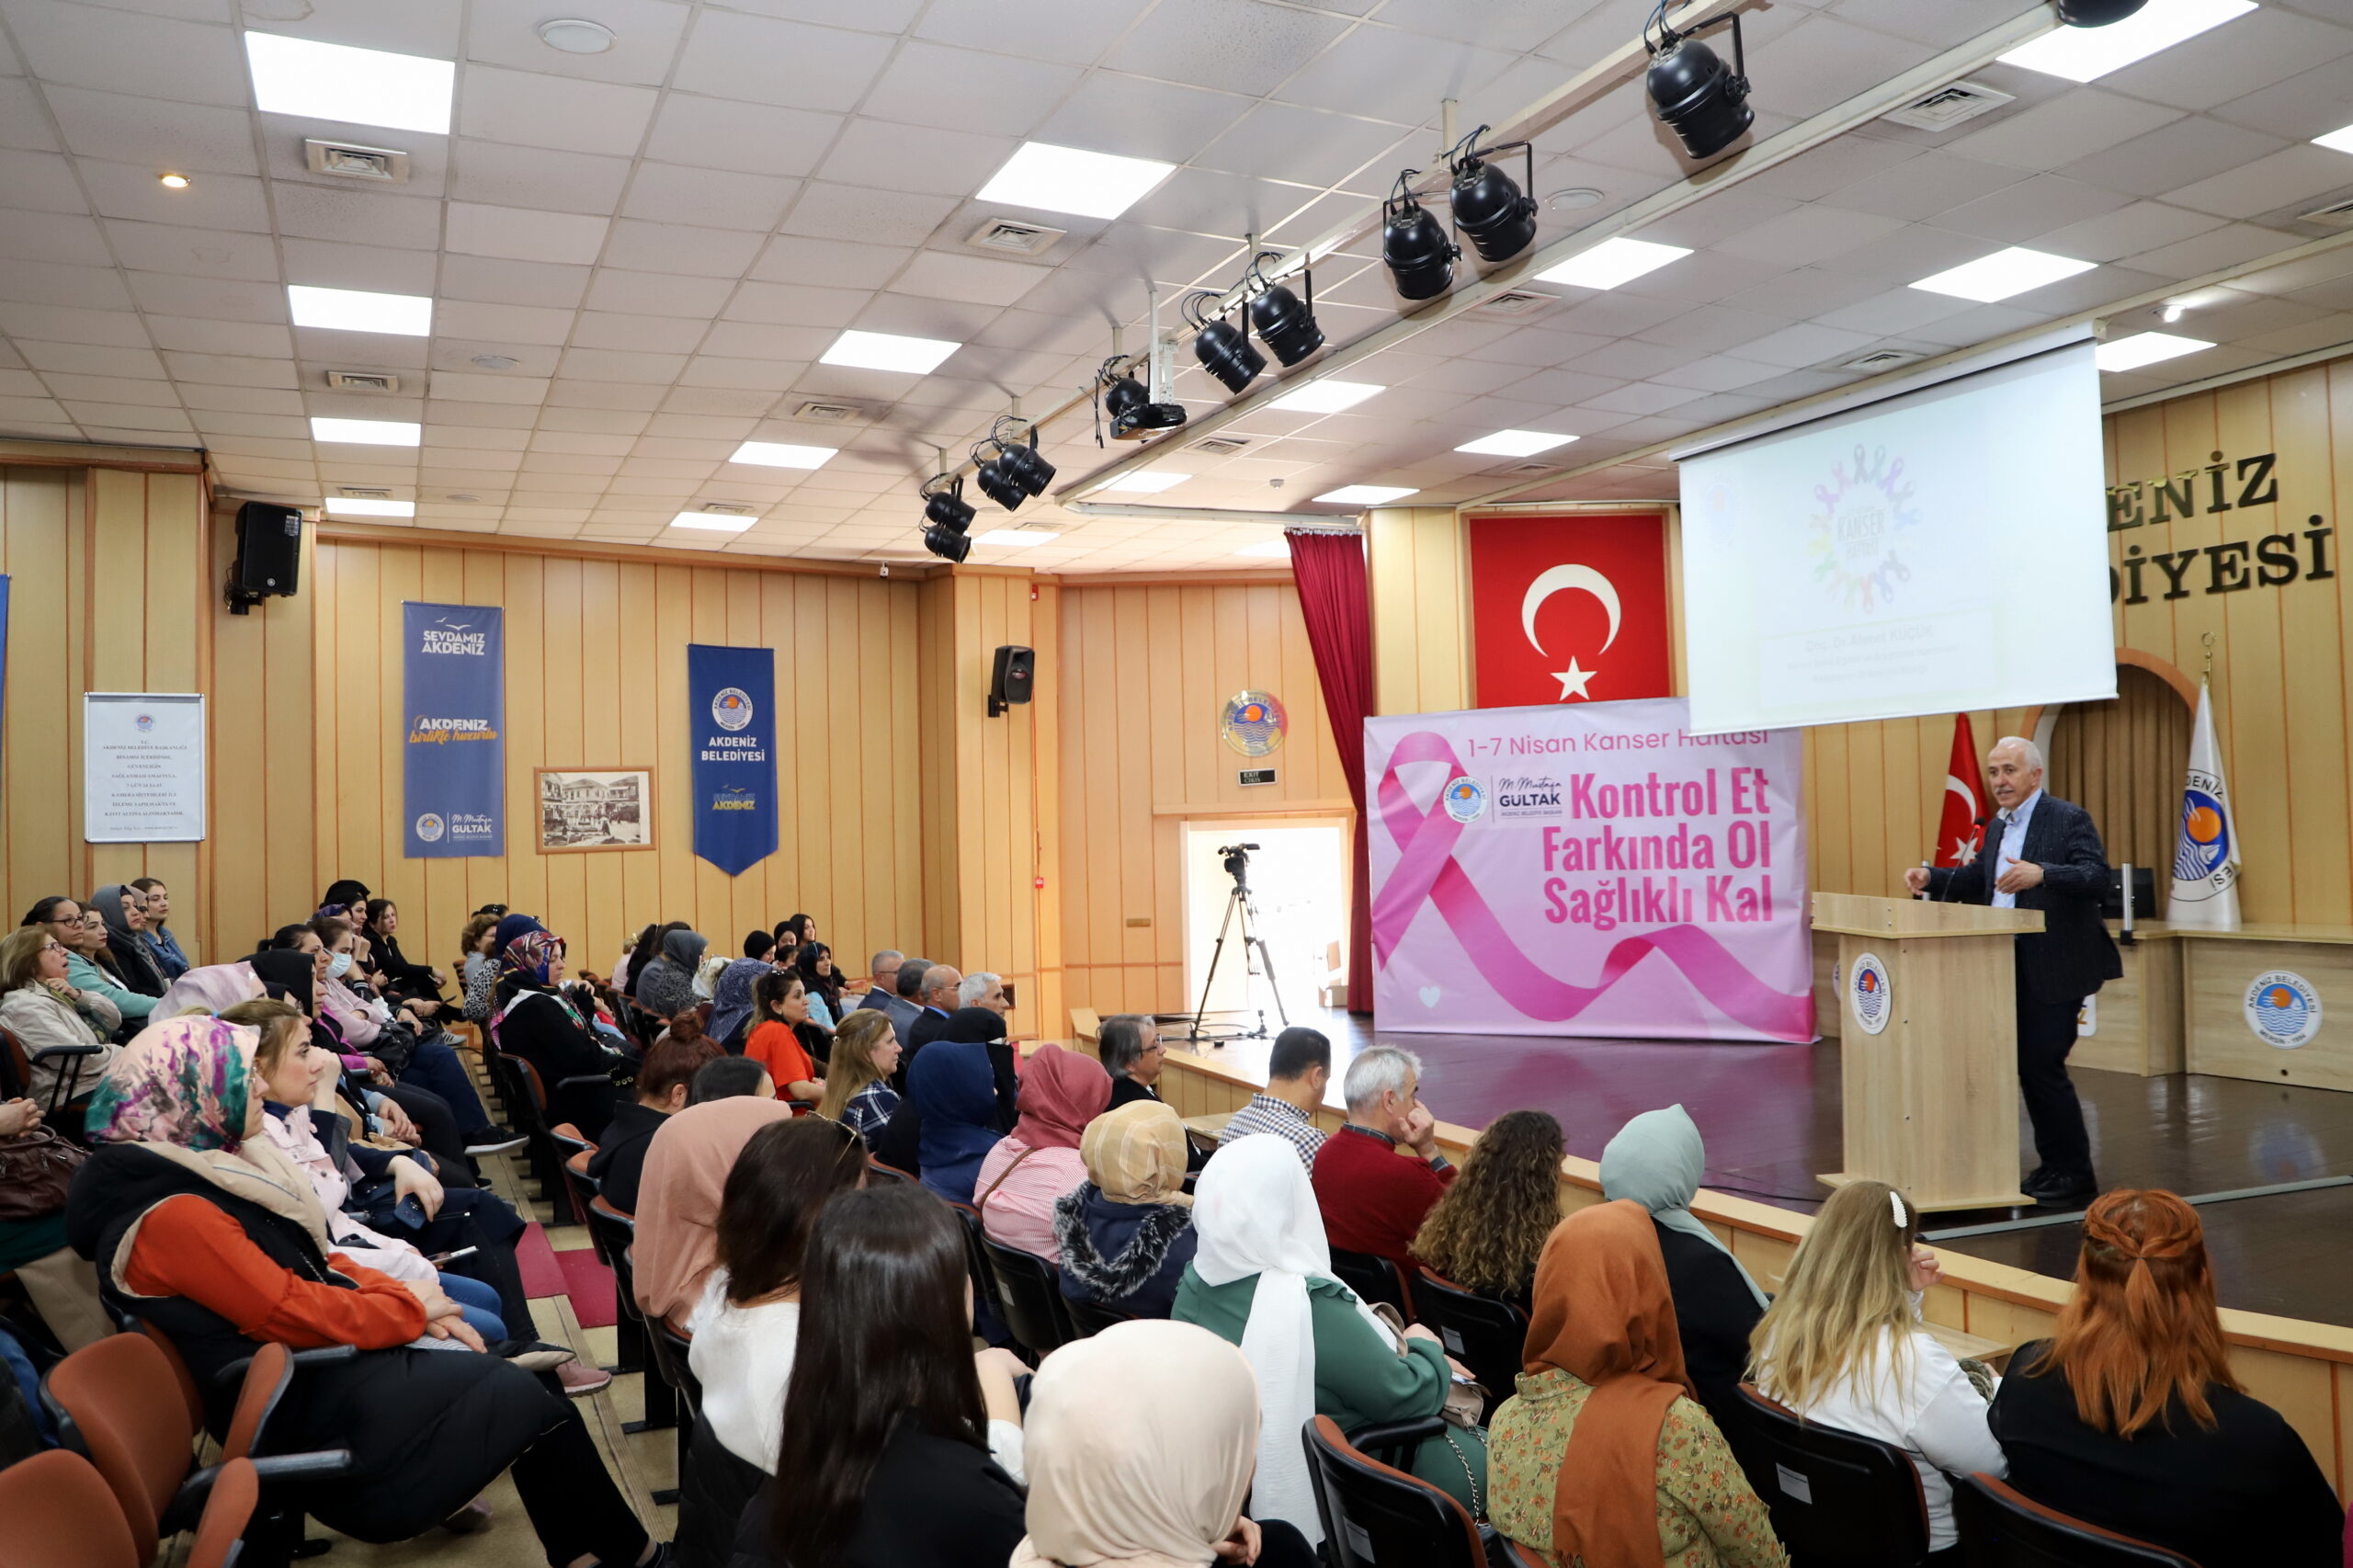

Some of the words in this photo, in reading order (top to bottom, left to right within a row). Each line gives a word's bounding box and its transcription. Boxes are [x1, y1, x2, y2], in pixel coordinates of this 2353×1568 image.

[423, 631, 485, 643] SEVDAMIZ
[709, 735, 756, 747] AKDENİZ
[1510, 735, 1575, 756] Nisan
[1585, 732, 1669, 752] Kanser
[701, 749, 765, 761] BELEDİYESİ
[1570, 767, 1717, 819] Kontrol
[1731, 767, 1770, 814] Et
[1542, 823, 1715, 871] Farkında
[1727, 820, 1771, 869] Ol
[1543, 876, 1693, 931] Sağlıklı
[1706, 874, 1772, 923] Kal
